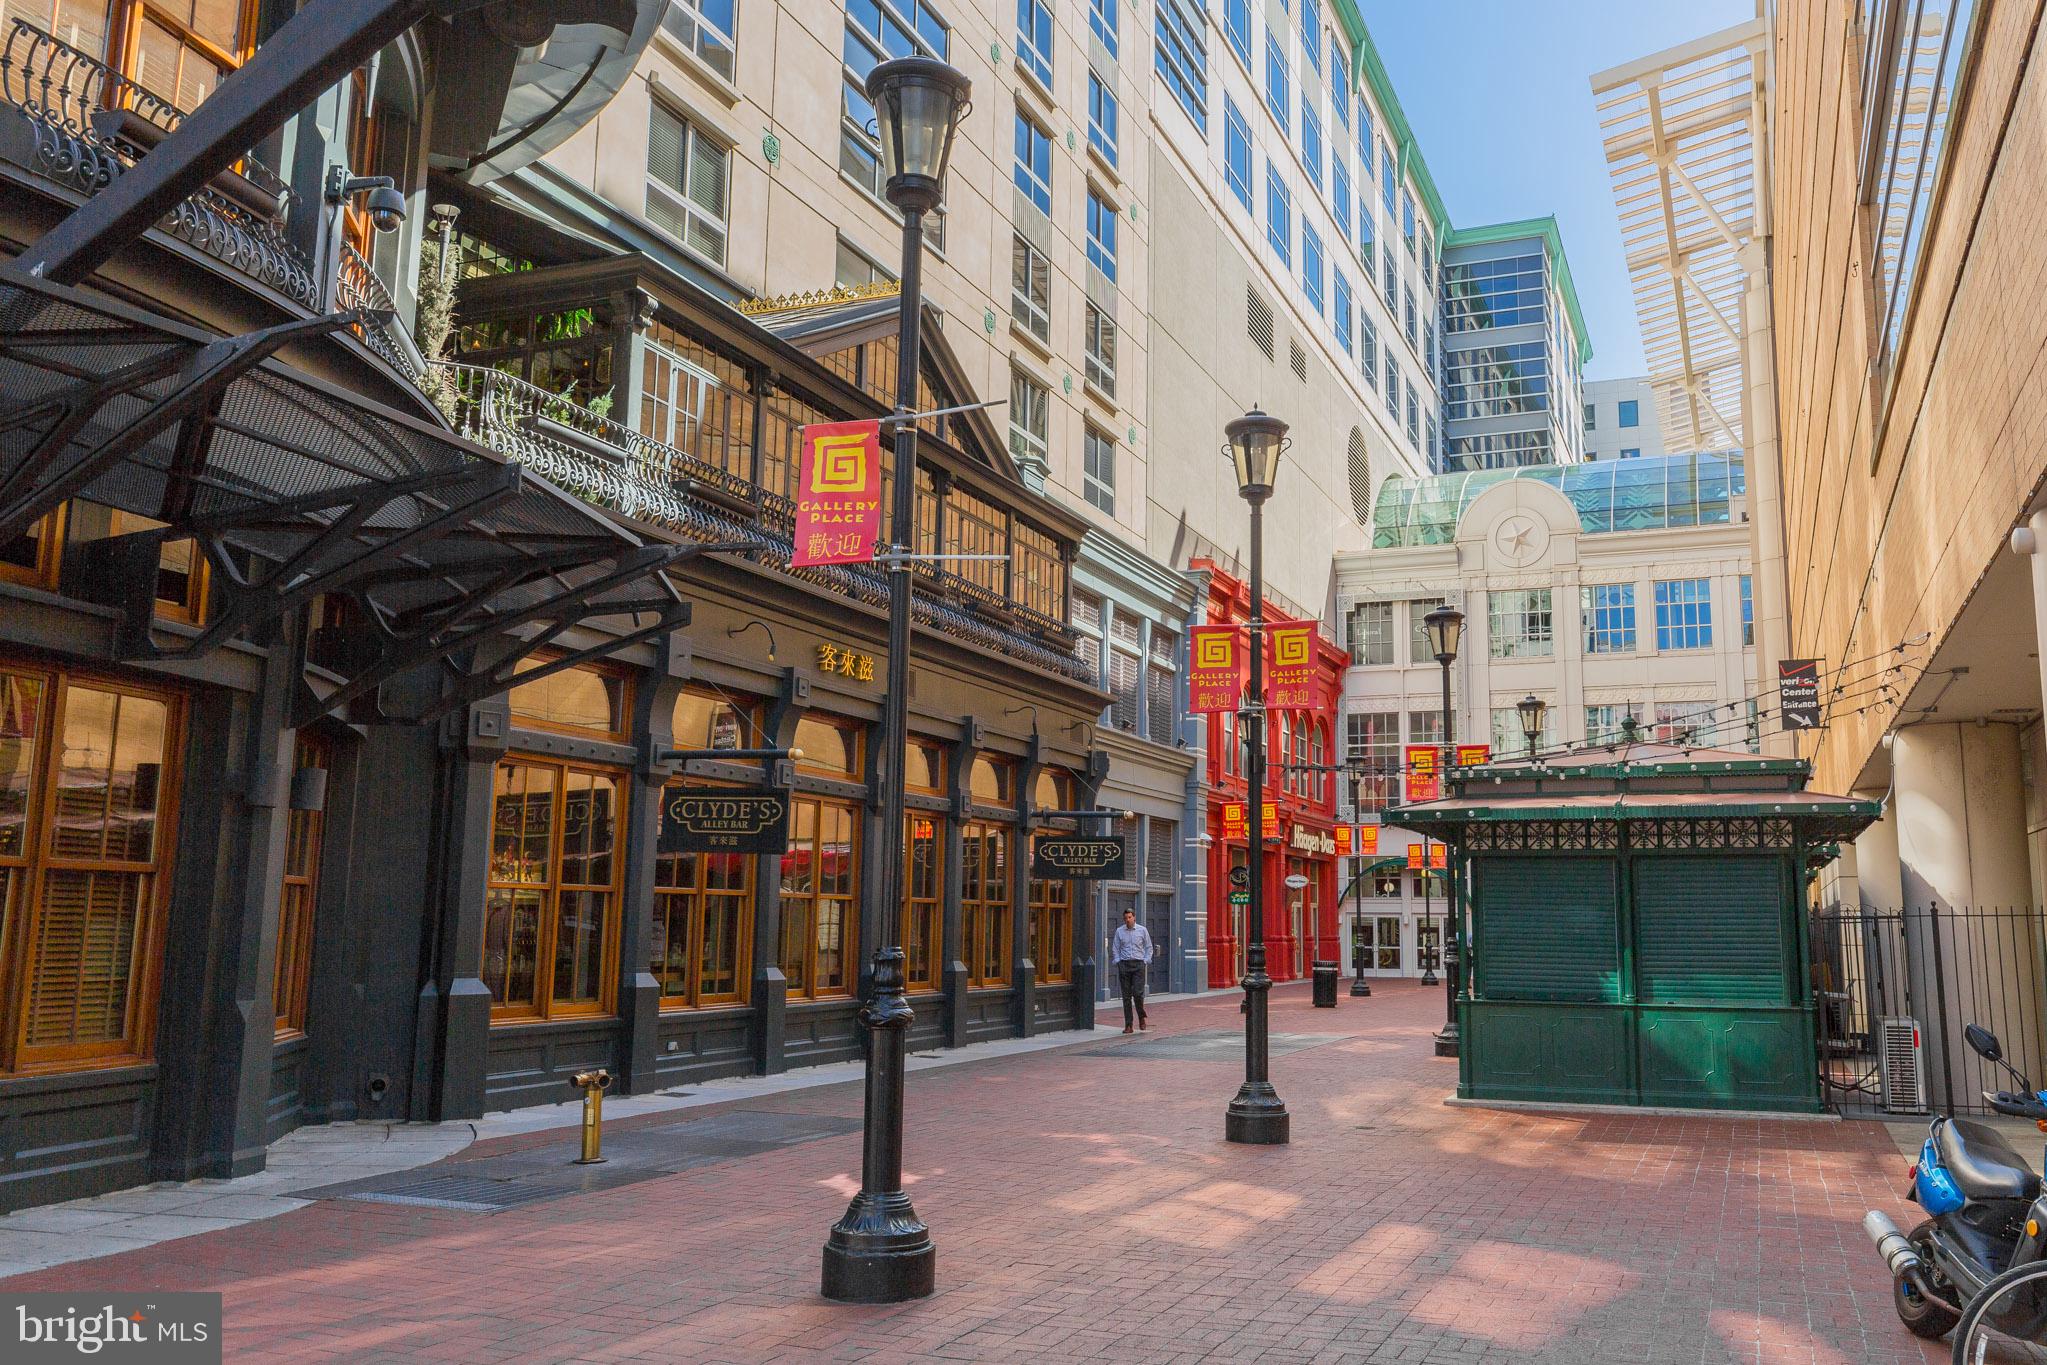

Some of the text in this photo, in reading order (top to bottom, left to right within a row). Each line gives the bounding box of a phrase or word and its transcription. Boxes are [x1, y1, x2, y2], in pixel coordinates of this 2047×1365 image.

[800, 501, 878, 512] GALLERY
[810, 514, 864, 523] PLACE
[807, 532, 862, 560] 歡迎
[1191, 672, 1239, 680] GALLERY
[1270, 669, 1317, 678] GALLERY
[1277, 677, 1309, 685] PLACE
[1781, 688, 1817, 697] Center
[1782, 700, 1817, 709] Entrance
[681, 801, 771, 819] CLYDE'S
[700, 820, 749, 829] ALLEY BAR
[1048, 845, 1112, 857] CLYDE'S
